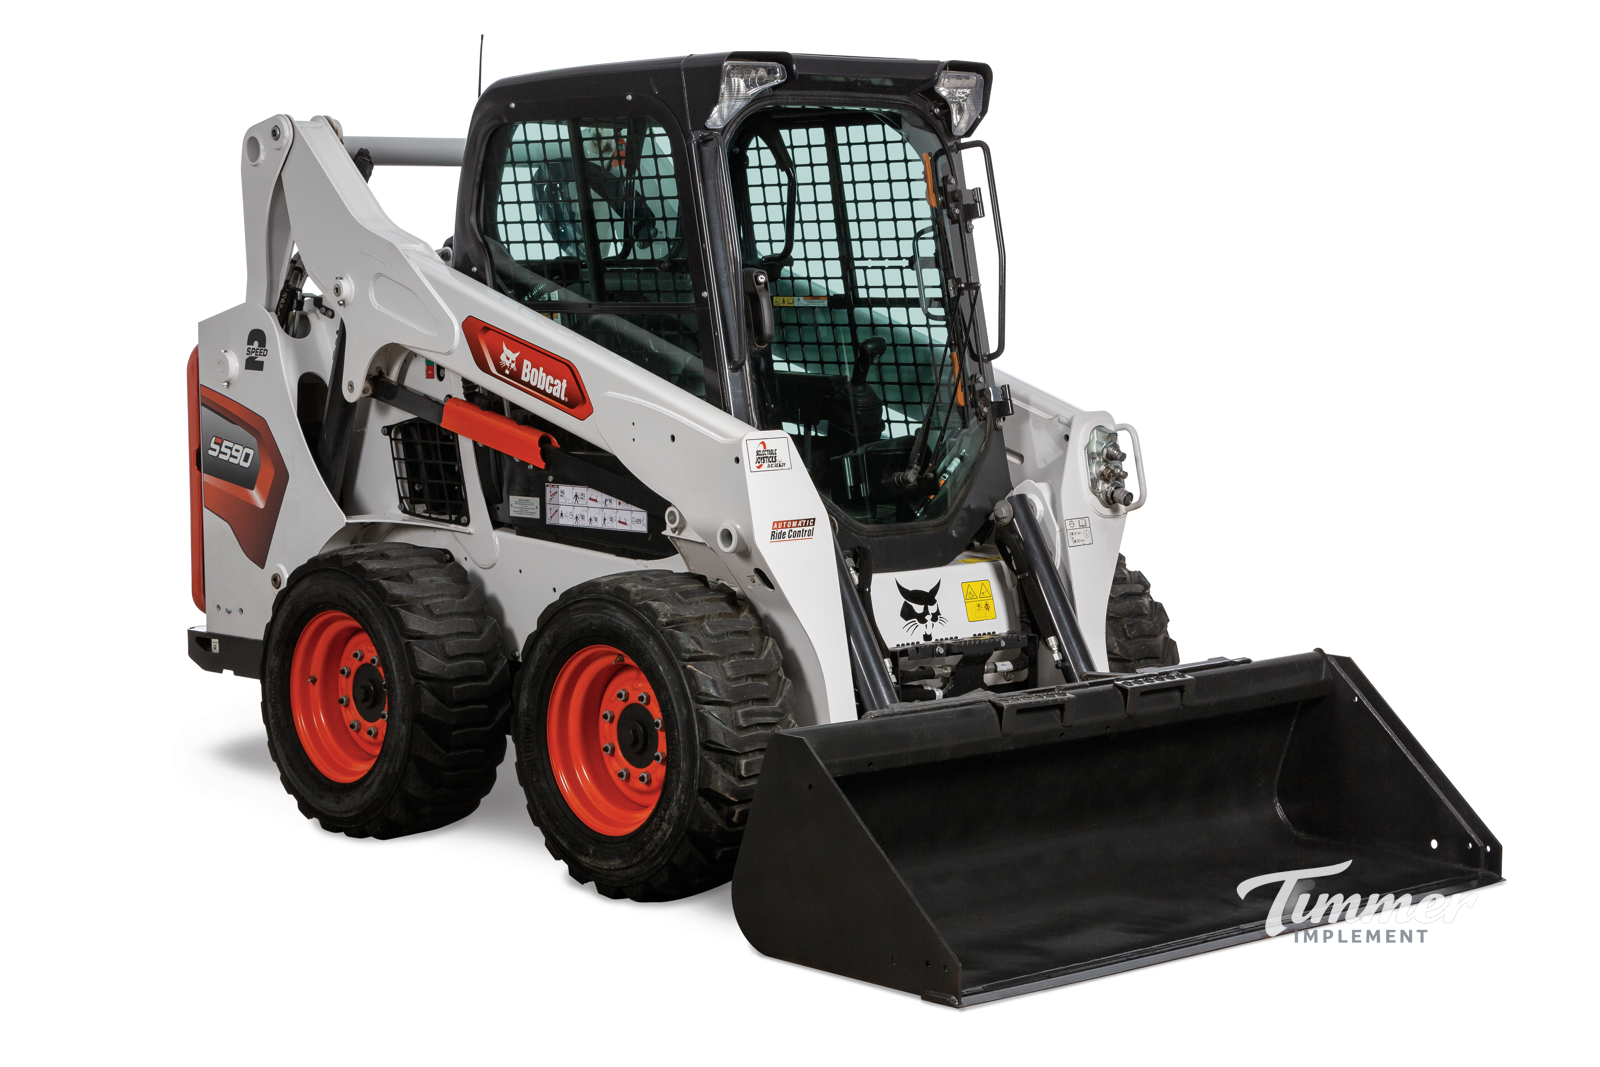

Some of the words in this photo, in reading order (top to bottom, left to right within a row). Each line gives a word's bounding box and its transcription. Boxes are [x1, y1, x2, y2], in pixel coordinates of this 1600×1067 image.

[246, 347, 268, 357] SPEED
[521, 359, 567, 401] Bobcat
[208, 436, 254, 468] S590
[755, 456, 777, 464] JOYSTICKS
[773, 519, 814, 529] AUTOMATIC
[770, 530, 787, 541] Ride
[787, 527, 814, 539] Control
